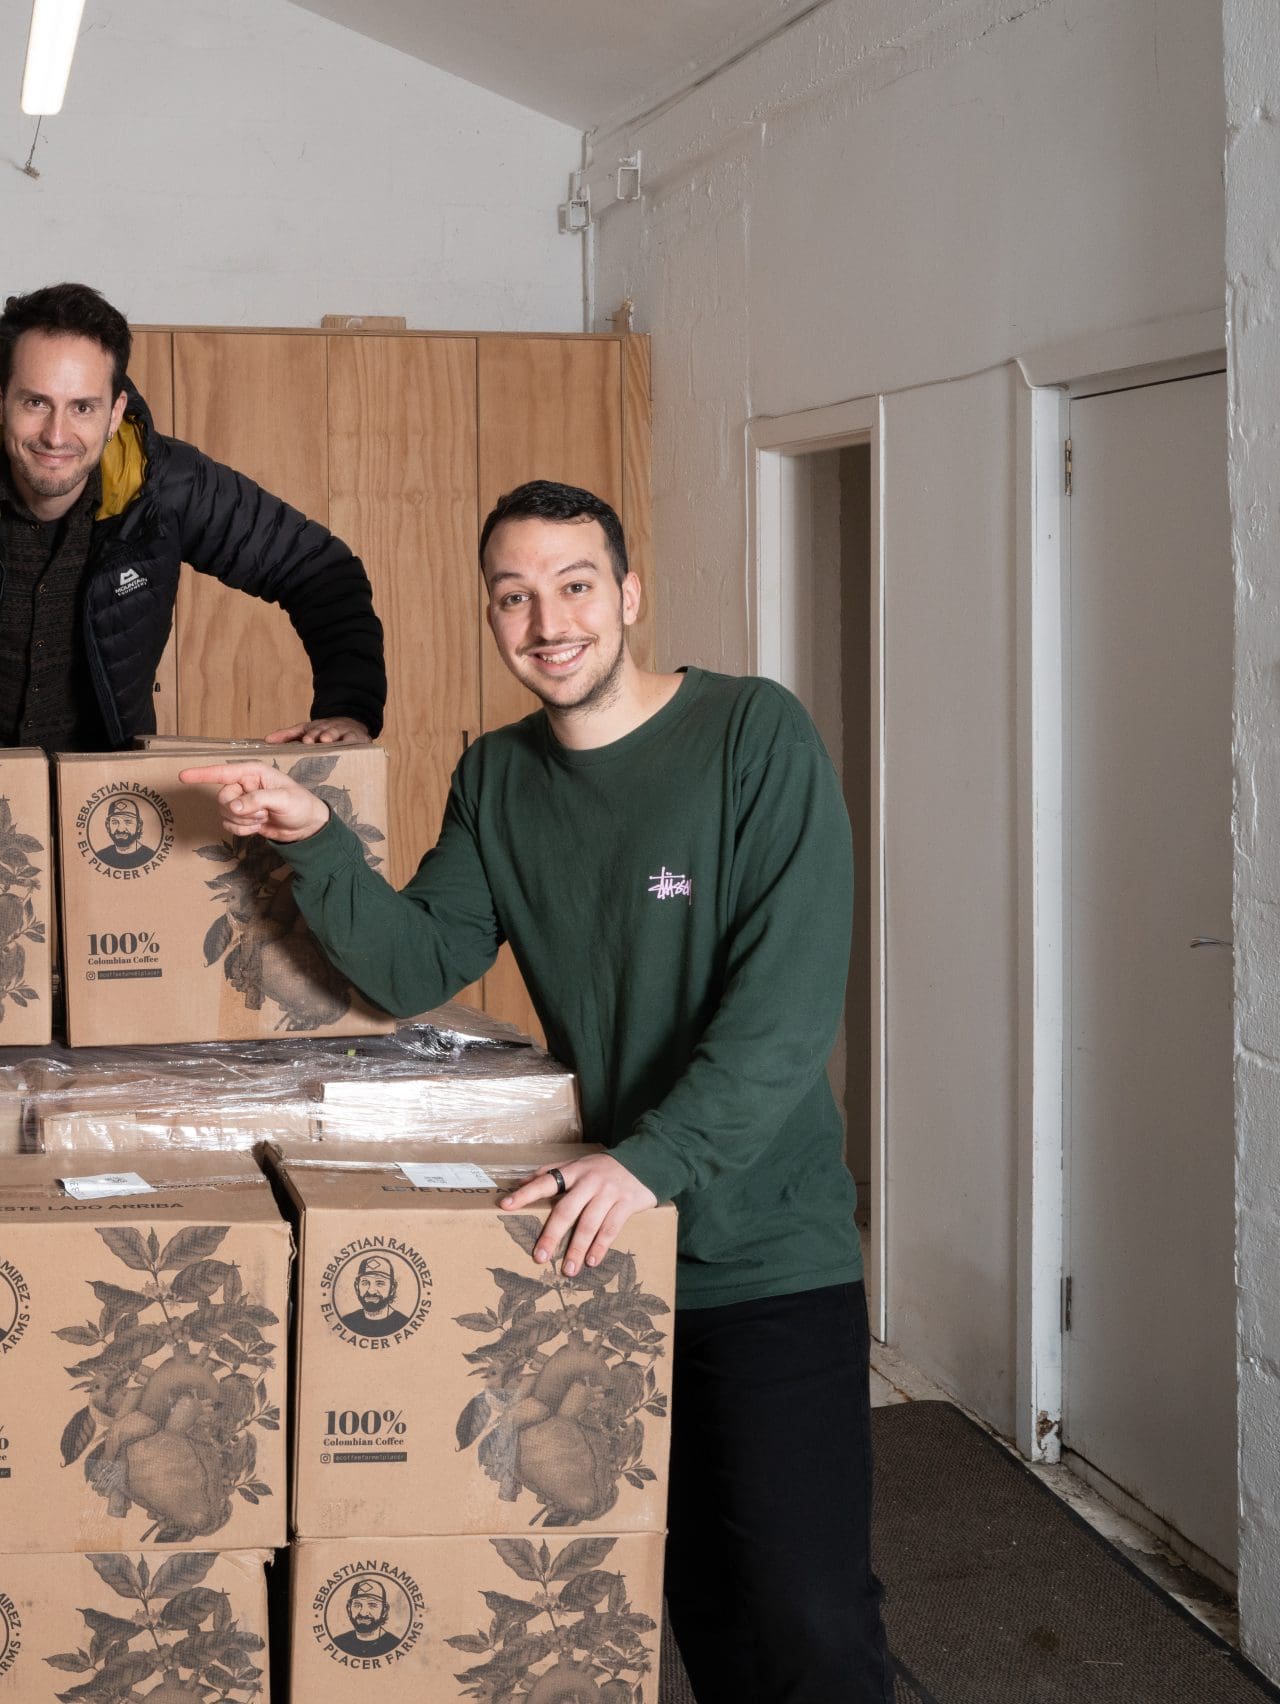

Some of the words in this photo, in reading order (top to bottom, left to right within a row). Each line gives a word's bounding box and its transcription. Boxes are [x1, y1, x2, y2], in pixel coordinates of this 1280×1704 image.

[75, 781, 129, 829] SEBASTIAN
[132, 782, 174, 826] RAMIREZ
[77, 839, 90, 858] EL
[87, 857, 141, 880] PLACER
[142, 834, 175, 875] FARMS
[86, 931, 160, 956] 100%
[88, 956, 132, 966] Colombian
[133, 955, 159, 964] Coffee
[108, 1202, 185, 1210] ARRIBA
[320, 1235, 384, 1290] SEBASTIAN
[387, 1237, 433, 1289] RAMIREZ
[320, 1303, 335, 1323] EL
[331, 1322, 391, 1350] PLACER
[394, 1298, 432, 1345] FARMS
[323, 1437, 373, 1447] Colombian
[375, 1436, 404, 1446] Coffee
[324, 1409, 407, 1436] 100%
[312, 1559, 377, 1612] SEBASTIAN
[379, 1561, 425, 1611] RAMIREZ
[312, 1623, 326, 1643] EL
[322, 1642, 382, 1670] PLACER
[384, 1620, 424, 1665] FARMS
